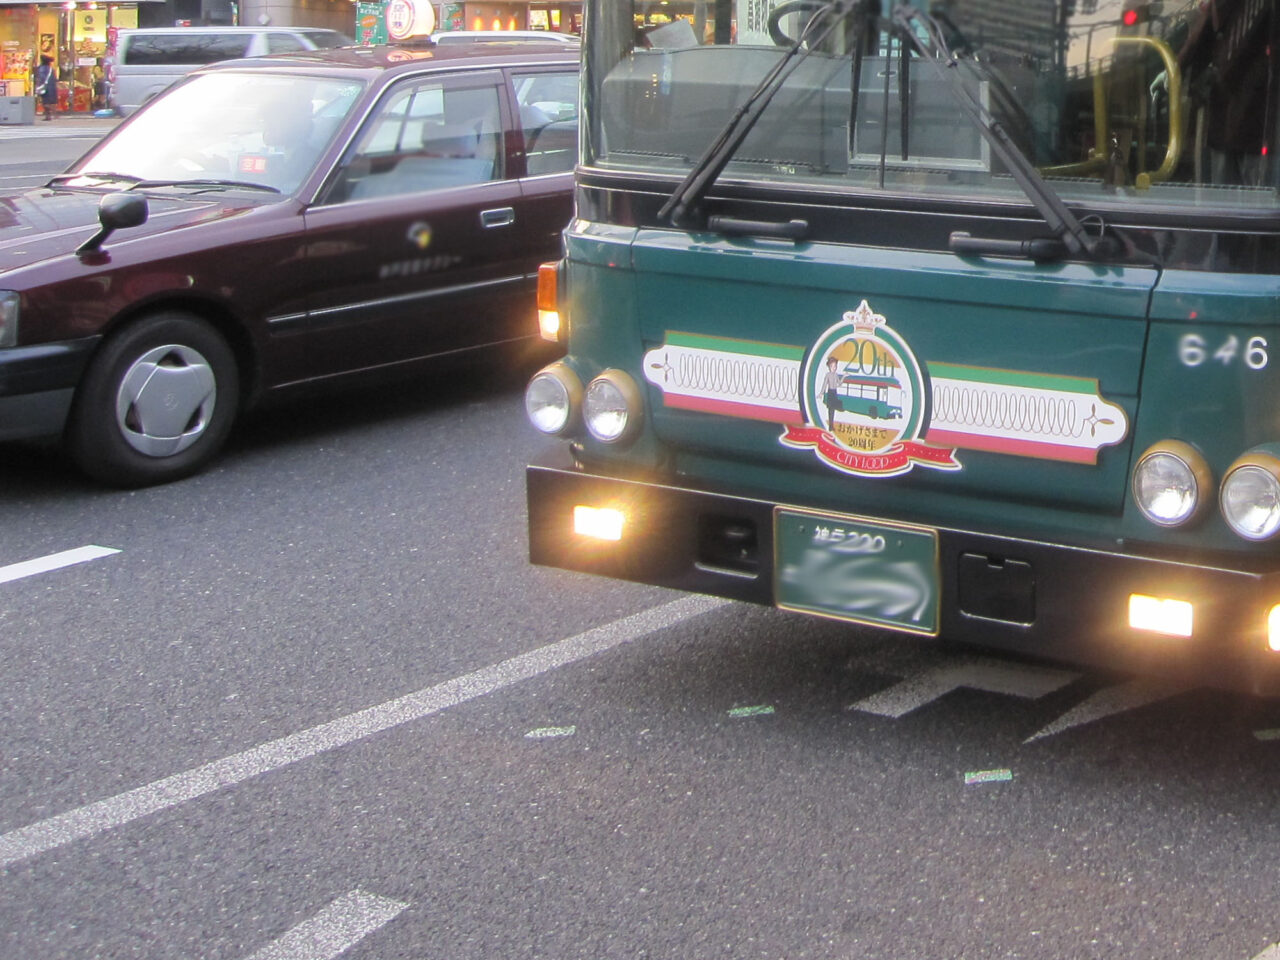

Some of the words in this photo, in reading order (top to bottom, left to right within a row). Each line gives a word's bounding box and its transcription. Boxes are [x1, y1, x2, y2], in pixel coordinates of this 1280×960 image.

[842, 337, 895, 379] 20th
[1178, 333, 1268, 370] 646
[837, 423, 888, 440] おかげさまで
[848, 438, 877, 450] 20周年
[836, 451, 860, 468] CITY
